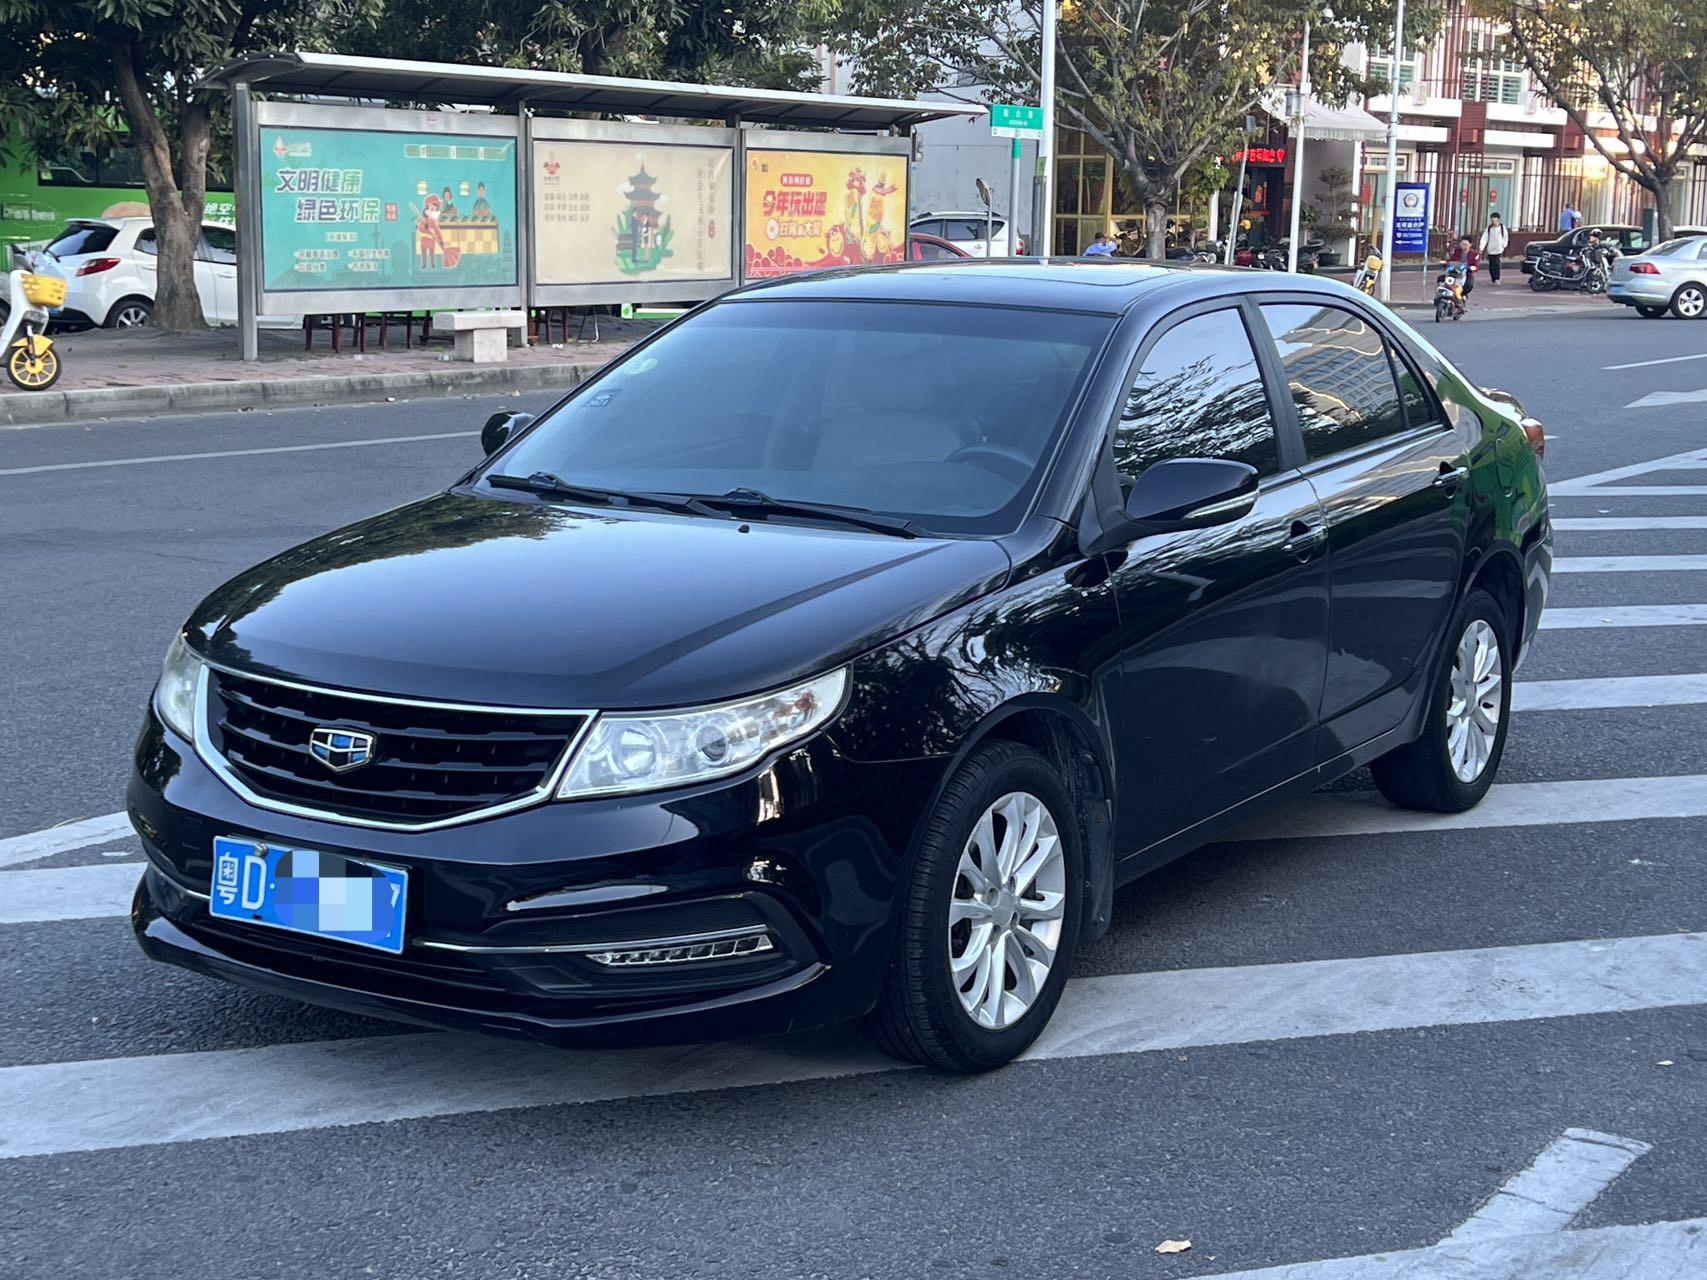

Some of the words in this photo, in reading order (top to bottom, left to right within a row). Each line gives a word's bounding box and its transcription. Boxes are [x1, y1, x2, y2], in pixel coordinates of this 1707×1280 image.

[276, 168, 363, 193] 文明健康
[296, 198, 380, 223] 绿色环保
